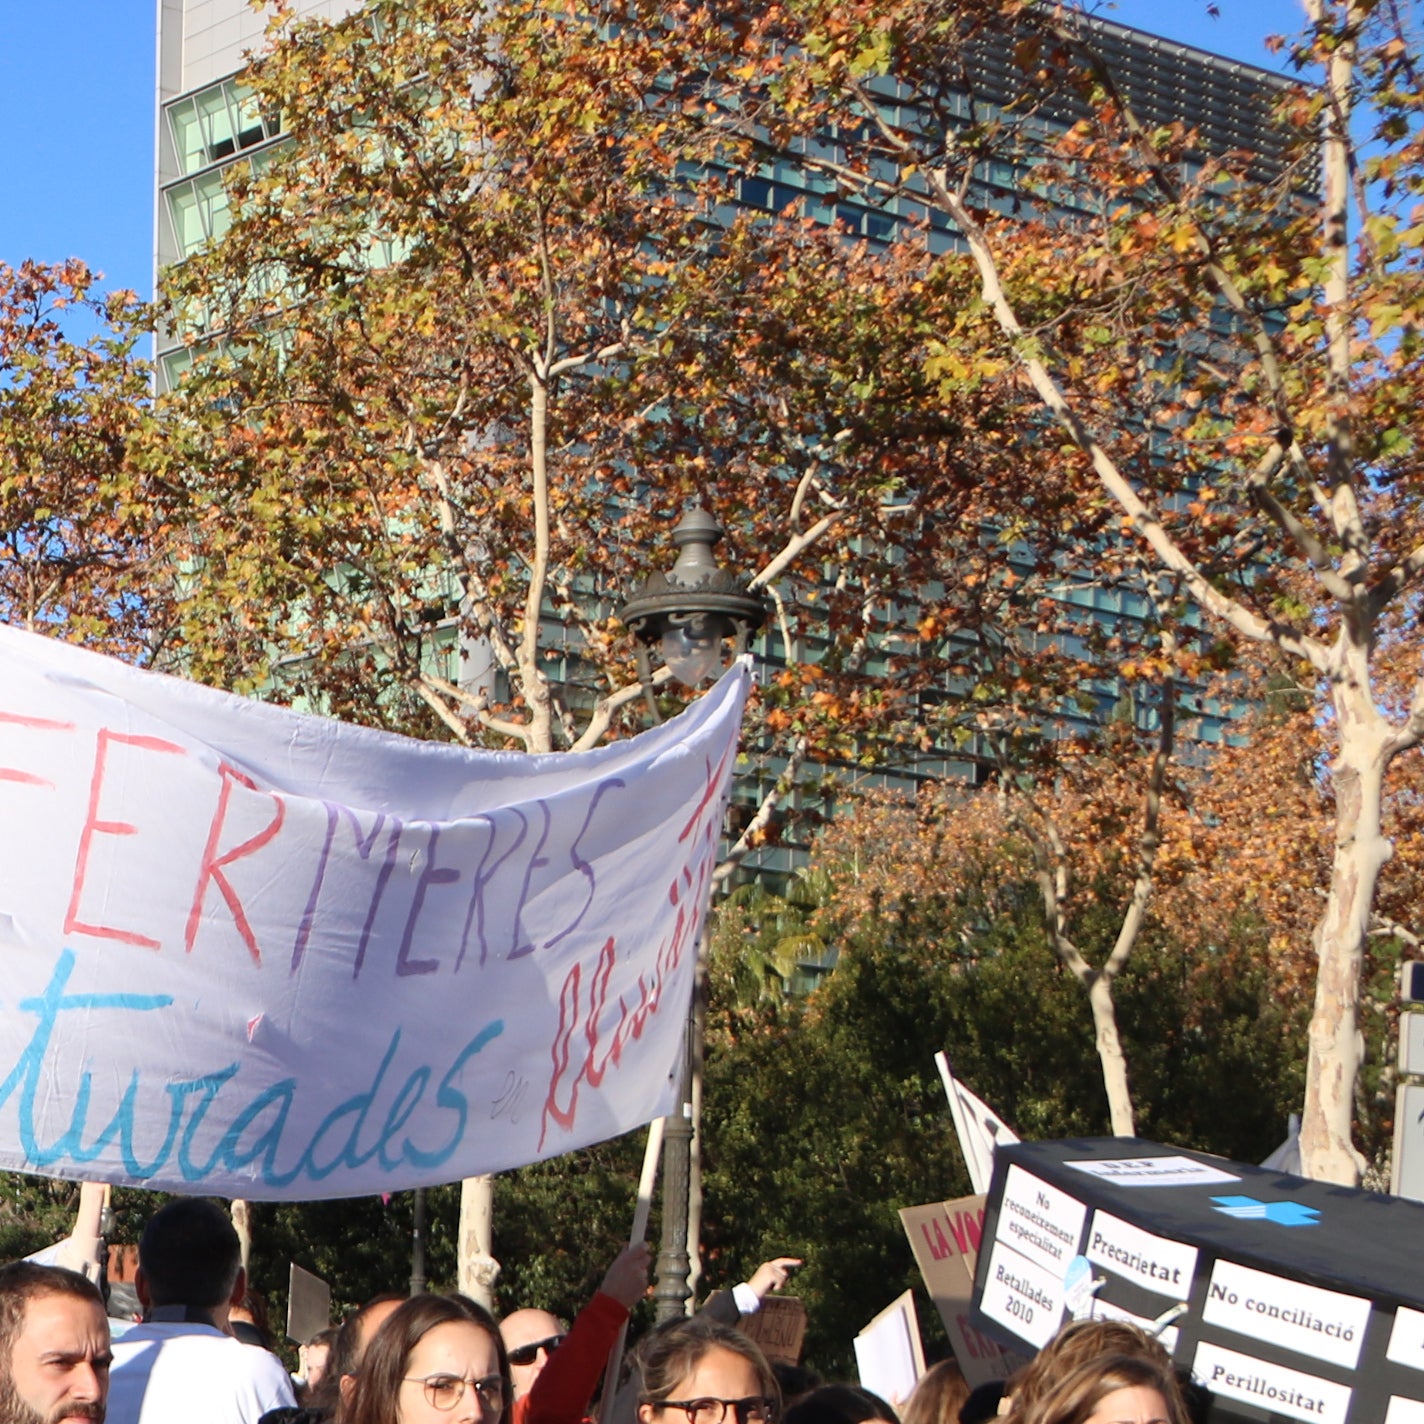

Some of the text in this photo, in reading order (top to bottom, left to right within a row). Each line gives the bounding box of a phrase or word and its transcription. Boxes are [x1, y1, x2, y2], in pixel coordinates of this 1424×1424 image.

[1004, 1196, 1075, 1247] reconeixement
[1036, 1191, 1050, 1211] No
[946, 1208, 986, 1256] VO
[1008, 1219, 1063, 1261] especialitat
[1091, 1232, 1182, 1286] Precarietat
[995, 1264, 1054, 1313] Retallades
[1004, 1294, 1034, 1325] 2010
[1210, 1281, 1356, 1343] No conciliació
[1211, 1364, 1326, 1416] Perillositat
